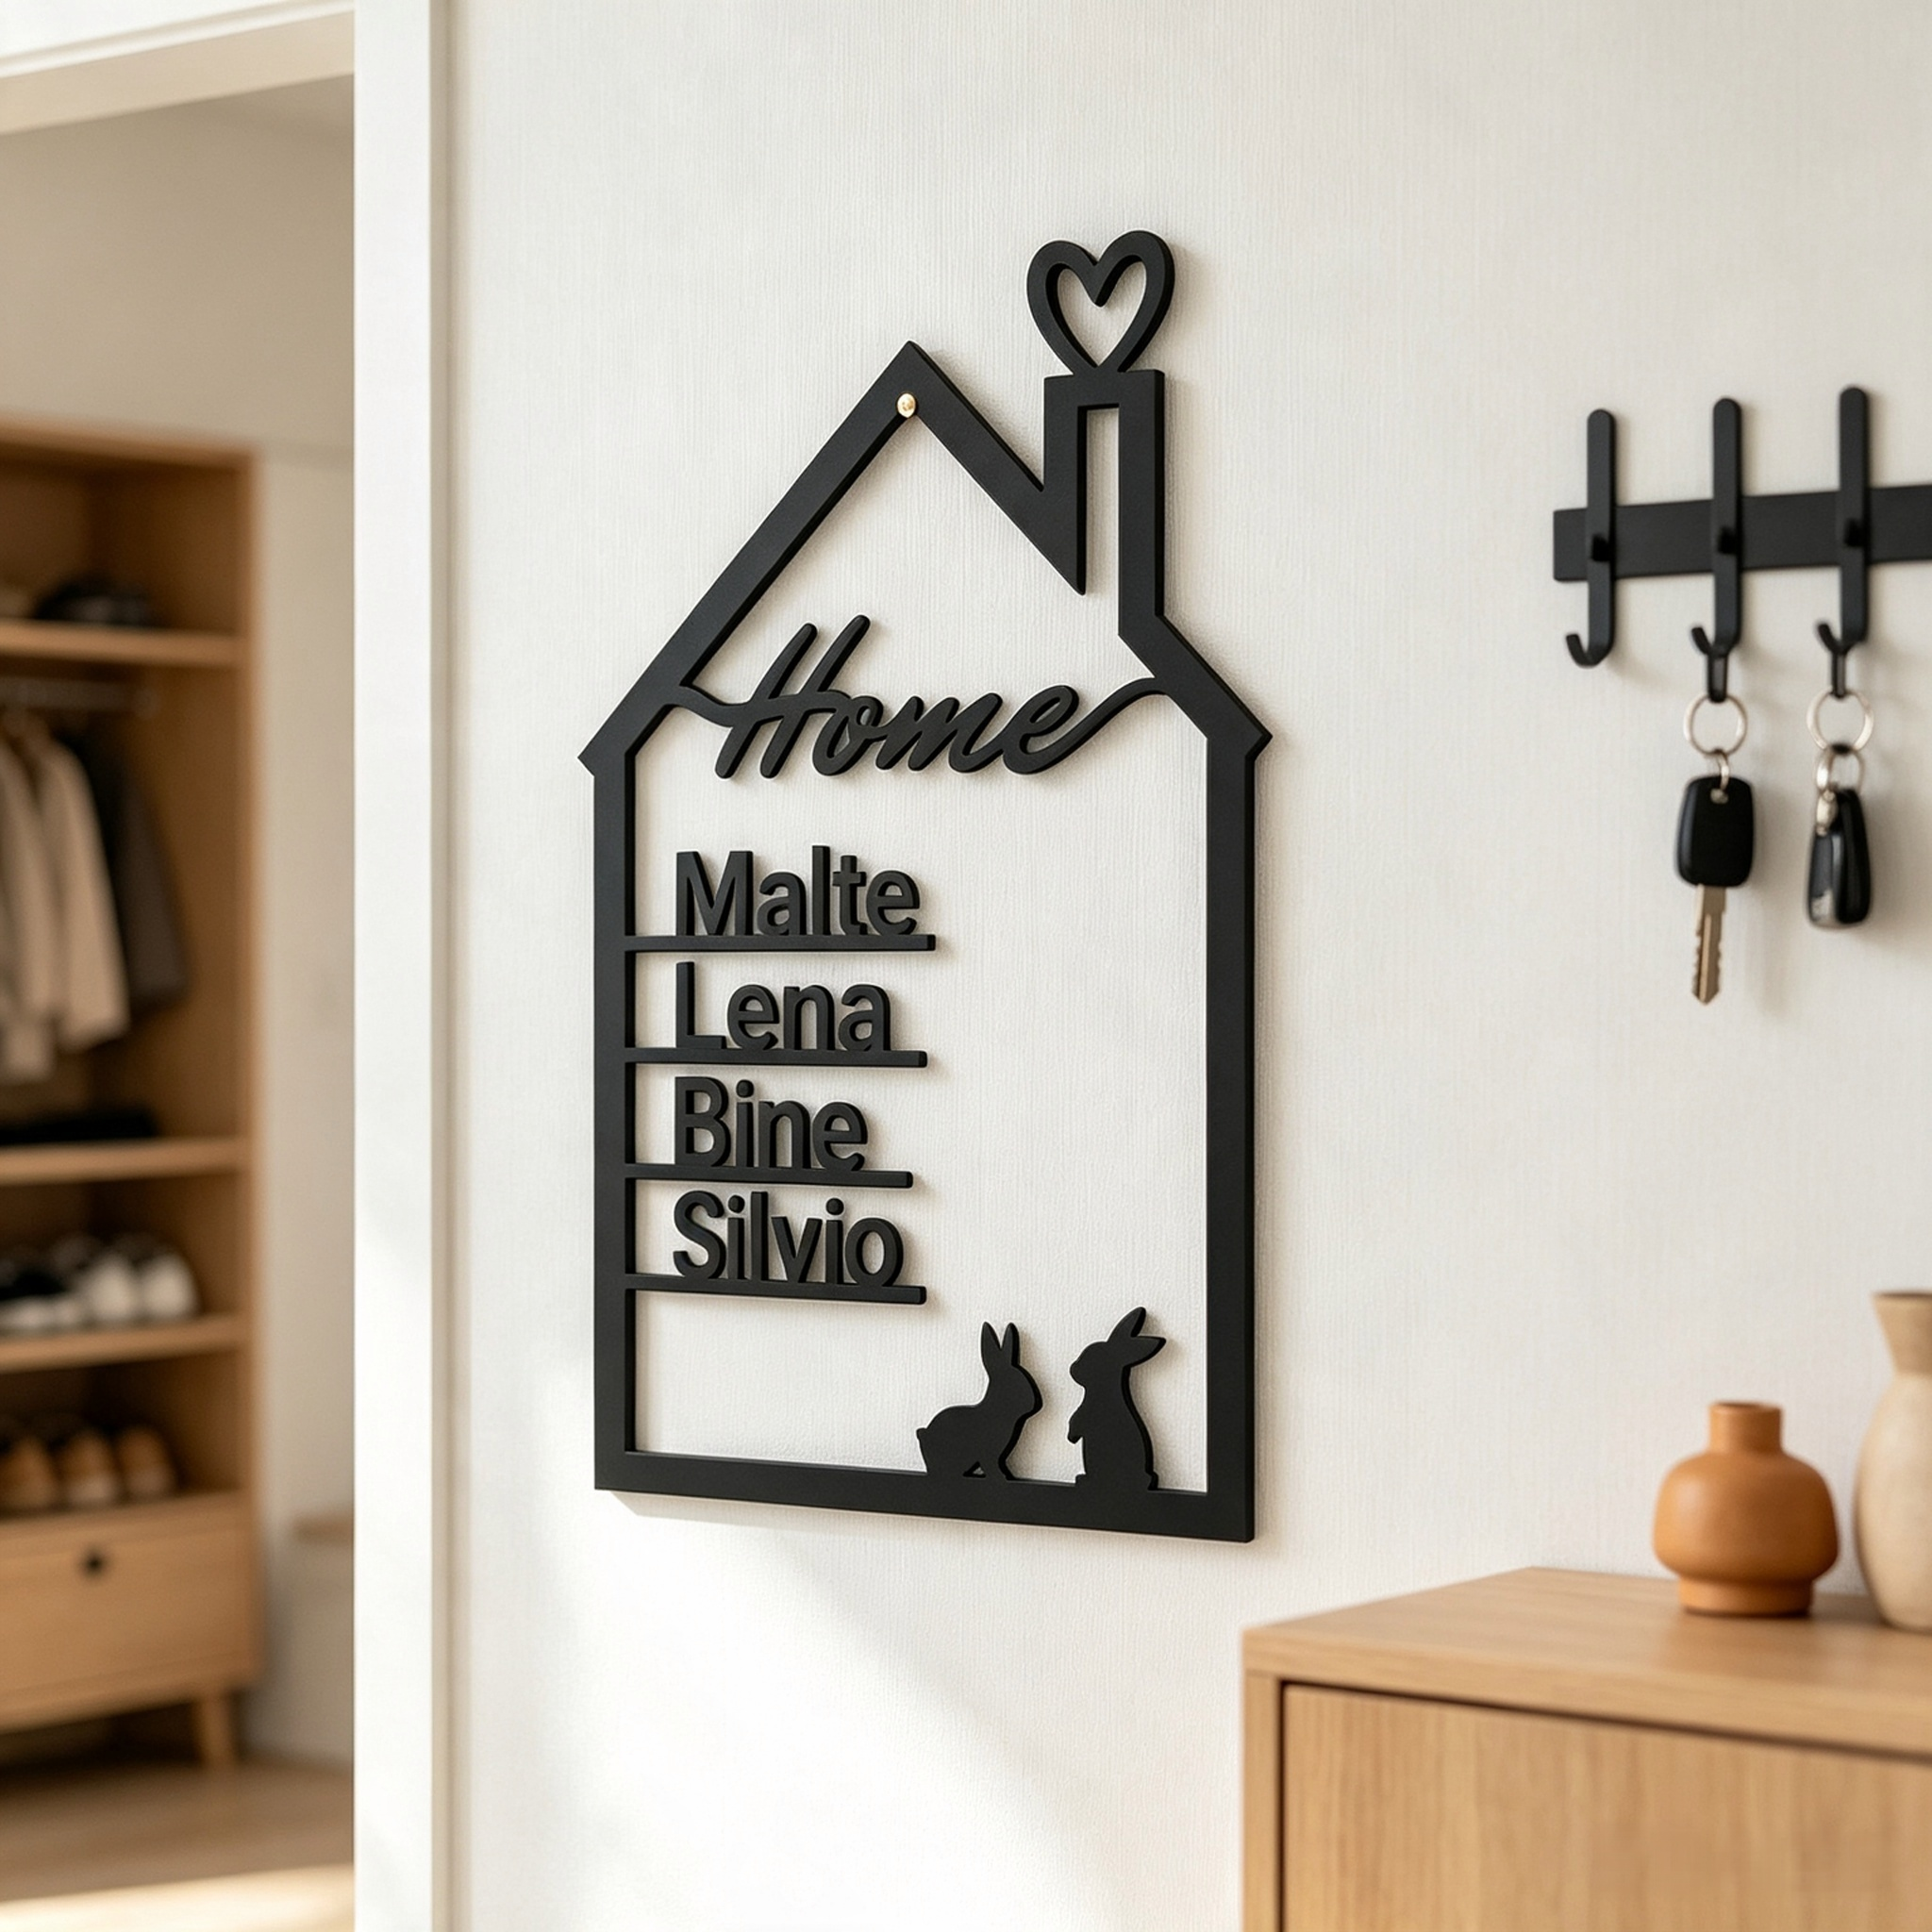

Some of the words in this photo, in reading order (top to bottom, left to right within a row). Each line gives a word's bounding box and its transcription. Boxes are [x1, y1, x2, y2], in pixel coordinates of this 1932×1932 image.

[709, 614, 1085, 779] Home
[675, 845, 921, 938] Malte
[675, 960, 891, 1053] Lena
[674, 1075, 869, 1172] Bine
[673, 1190, 905, 1287] Silvio
